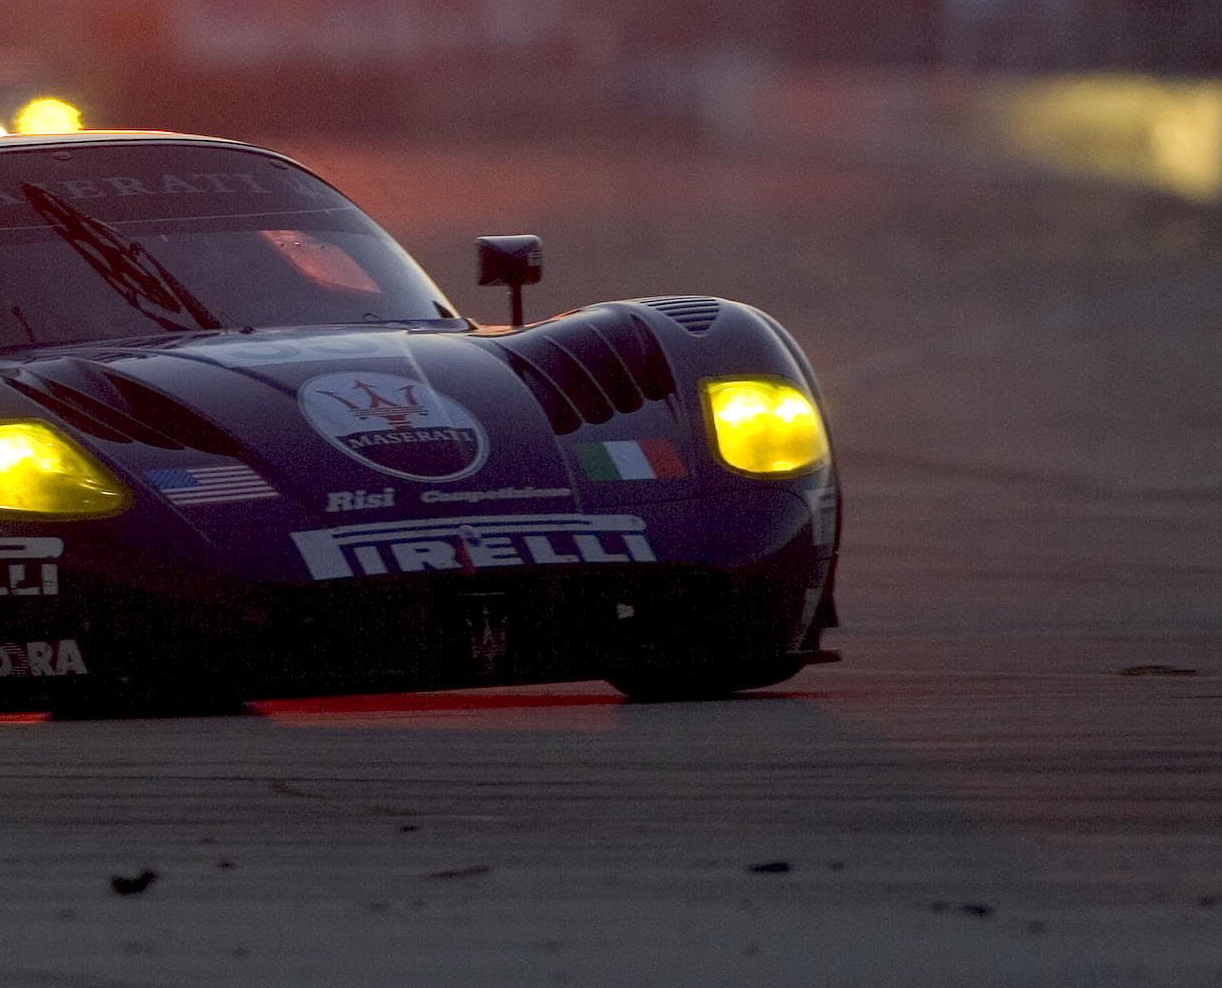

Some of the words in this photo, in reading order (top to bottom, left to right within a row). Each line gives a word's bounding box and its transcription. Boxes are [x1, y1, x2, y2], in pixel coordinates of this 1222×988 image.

[346, 428, 475, 450] MASERATI
[321, 486, 396, 513] Risi
[289, 513, 658, 581] PIRELLI
